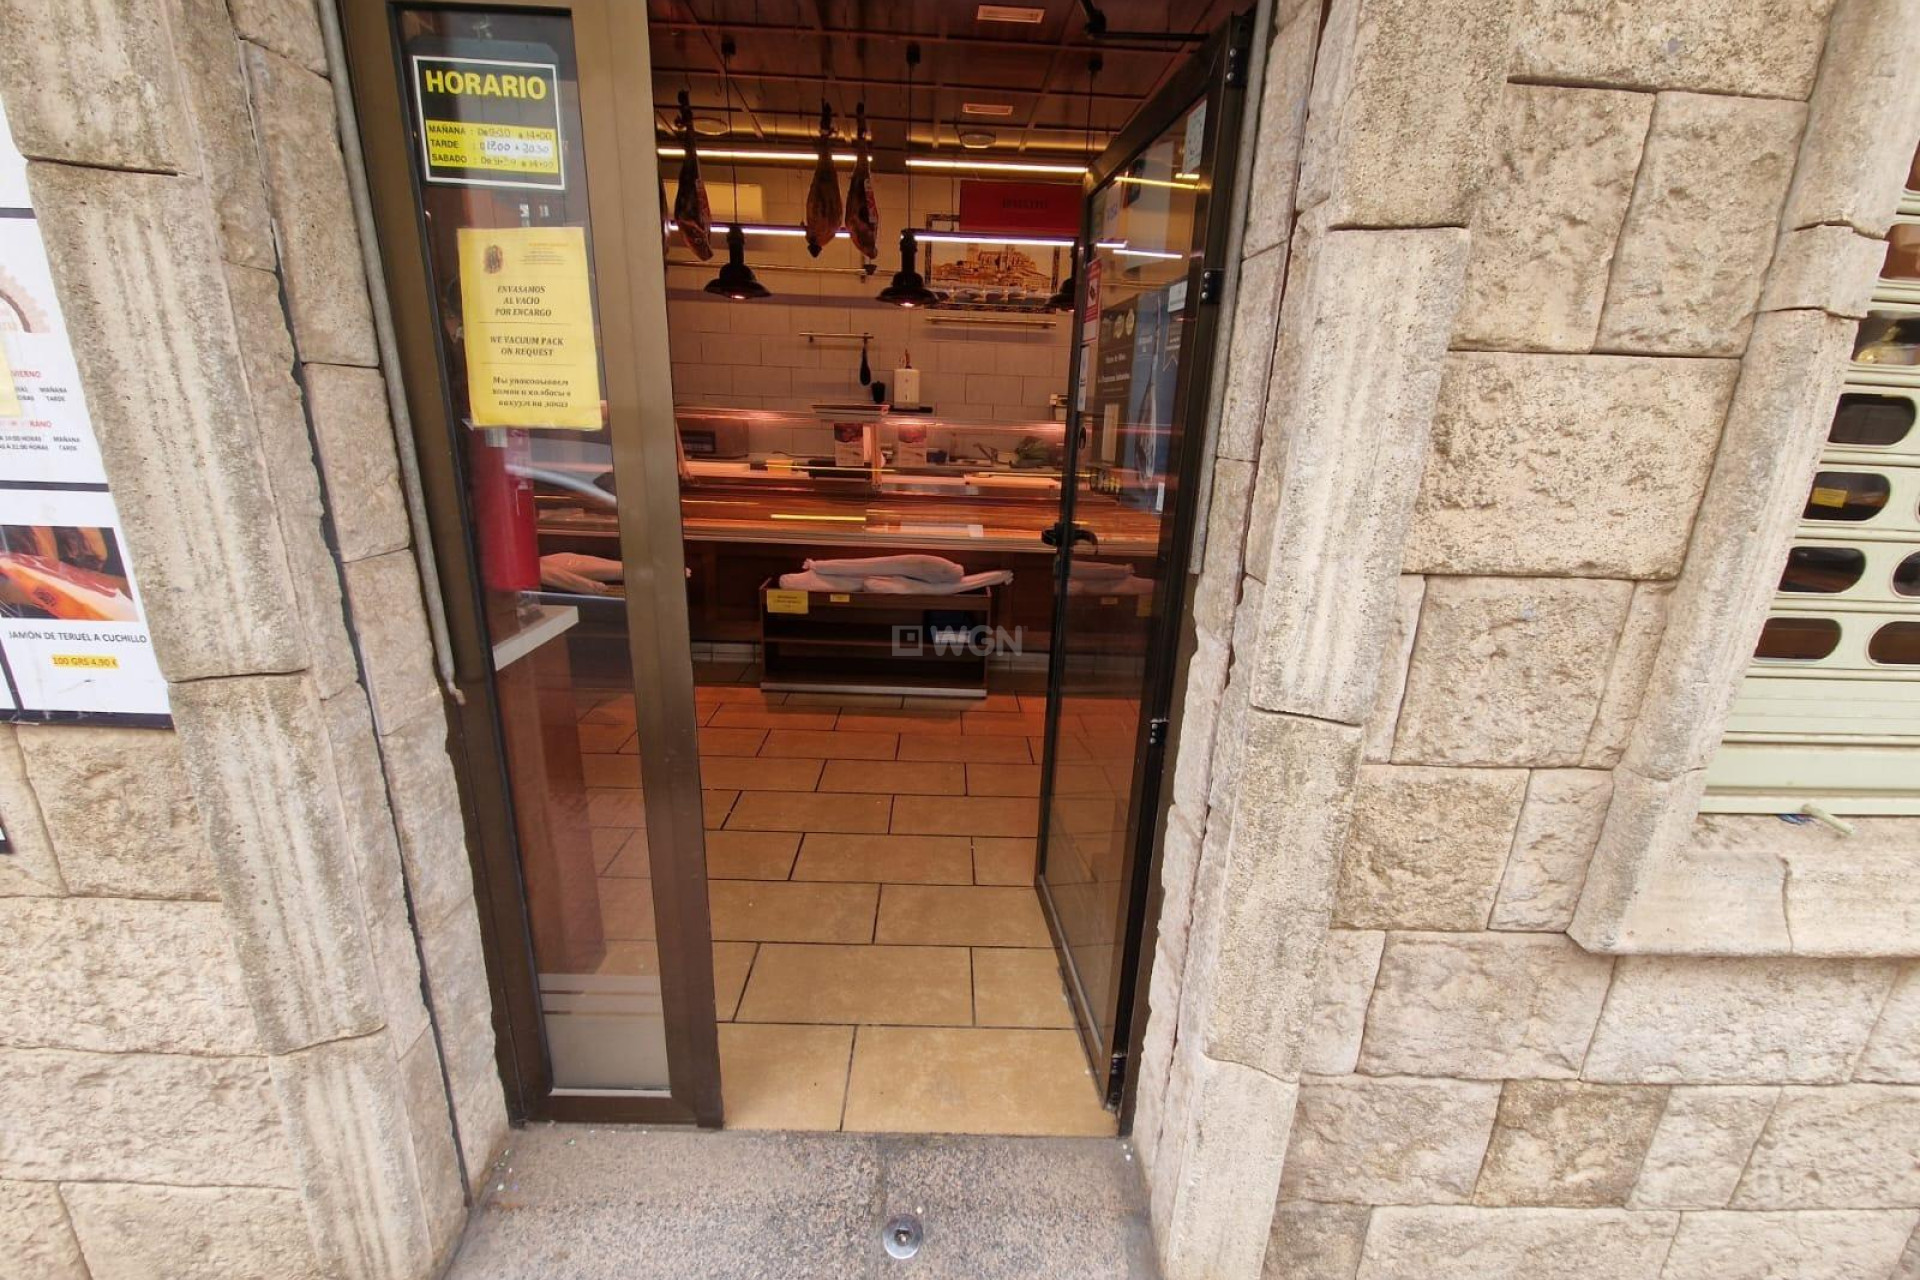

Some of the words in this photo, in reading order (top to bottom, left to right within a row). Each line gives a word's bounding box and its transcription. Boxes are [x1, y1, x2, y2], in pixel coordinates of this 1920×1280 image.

[425, 69, 547, 100] HORARIO
[430, 139, 460, 149] TARDE
[497, 285, 546, 294] ENVASAMOS
[503, 296, 514, 305] AL
[495, 307, 511, 316] POR
[513, 308, 552, 317] ENCARGO
[490, 335, 502, 344] WE
[504, 335, 540, 345] VACUUM
[541, 336, 565, 346] PACK
[501, 347, 513, 355] ON
[515, 348, 553, 357] REQUEST
[44, 632, 56, 640] DE
[58, 632, 92, 642] TERUEL
[102, 634, 147, 644] CUCHILLO
[53, 657, 69, 665] 100
[71, 657, 89, 666] GRS
